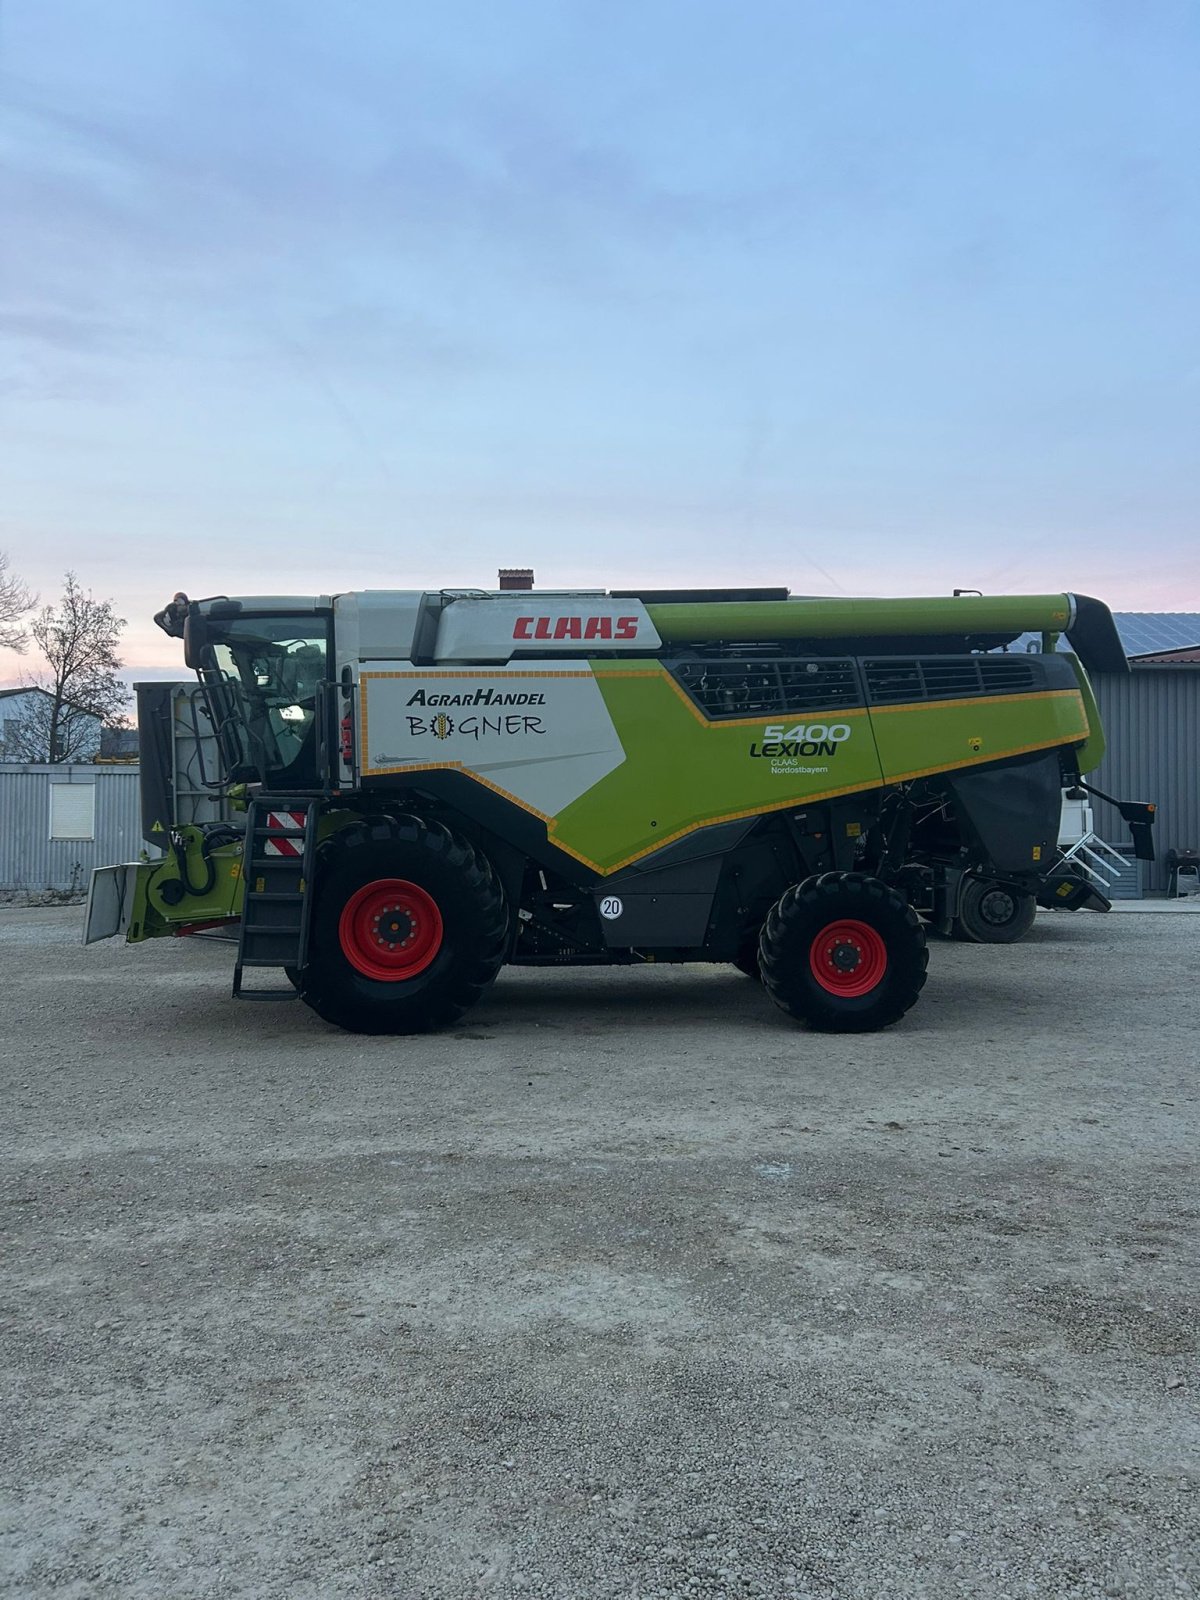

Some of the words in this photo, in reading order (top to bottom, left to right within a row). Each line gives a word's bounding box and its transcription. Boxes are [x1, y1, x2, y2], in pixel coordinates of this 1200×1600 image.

[513, 617, 639, 639] CLAAS
[763, 724, 851, 743] 5400
[749, 741, 838, 758] LEXION
[771, 758, 799, 767] CLAAS
[771, 766, 828, 774] Nordostbayern
[604, 900, 620, 915] 20
